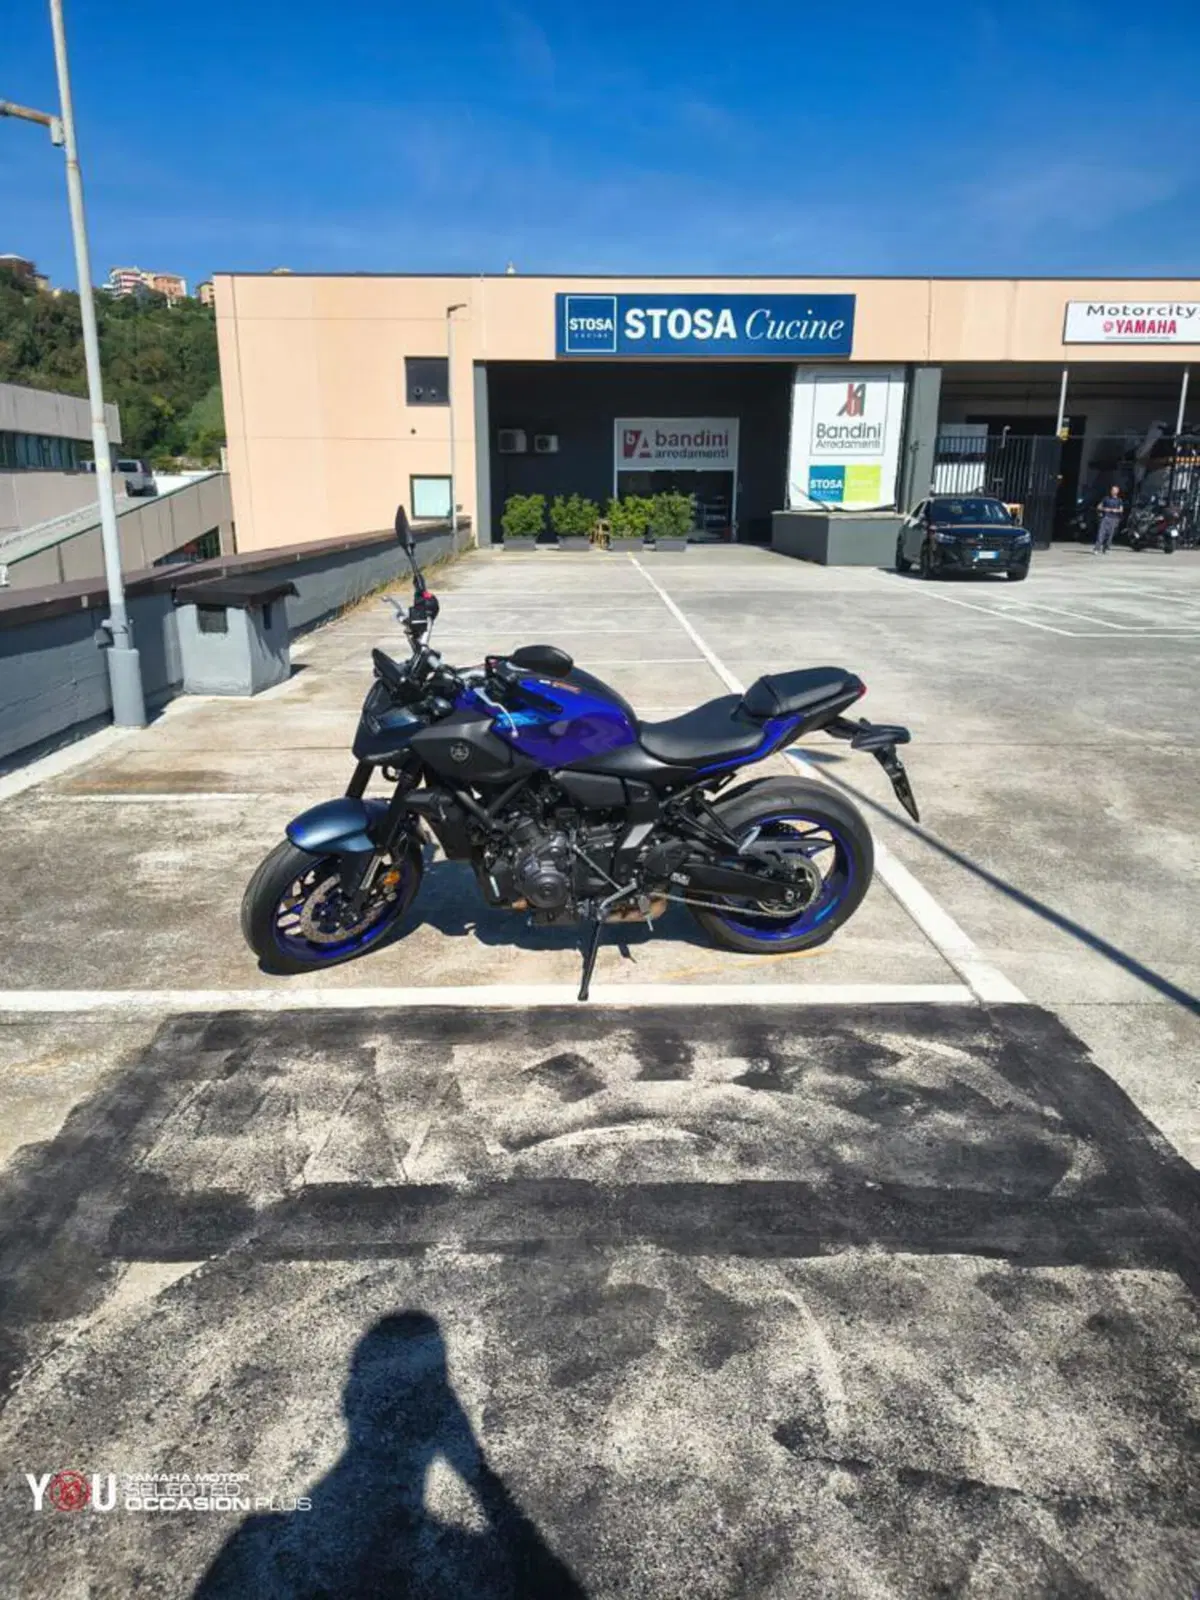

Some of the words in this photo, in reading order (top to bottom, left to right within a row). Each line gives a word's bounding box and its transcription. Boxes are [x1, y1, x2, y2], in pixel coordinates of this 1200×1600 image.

[1086, 304, 1197, 319] Motorcity
[569, 317, 613, 331] STOSA
[624, 308, 737, 340] STOSA
[745, 309, 845, 341] Cucine
[1115, 319, 1177, 334] YAMAHA
[655, 429, 729, 447] bandini
[816, 422, 881, 439] Bandini
[815, 439, 881, 449] Arredamenti
[655, 447, 729, 459] arredamenti
[810, 479, 843, 489] STOSA
